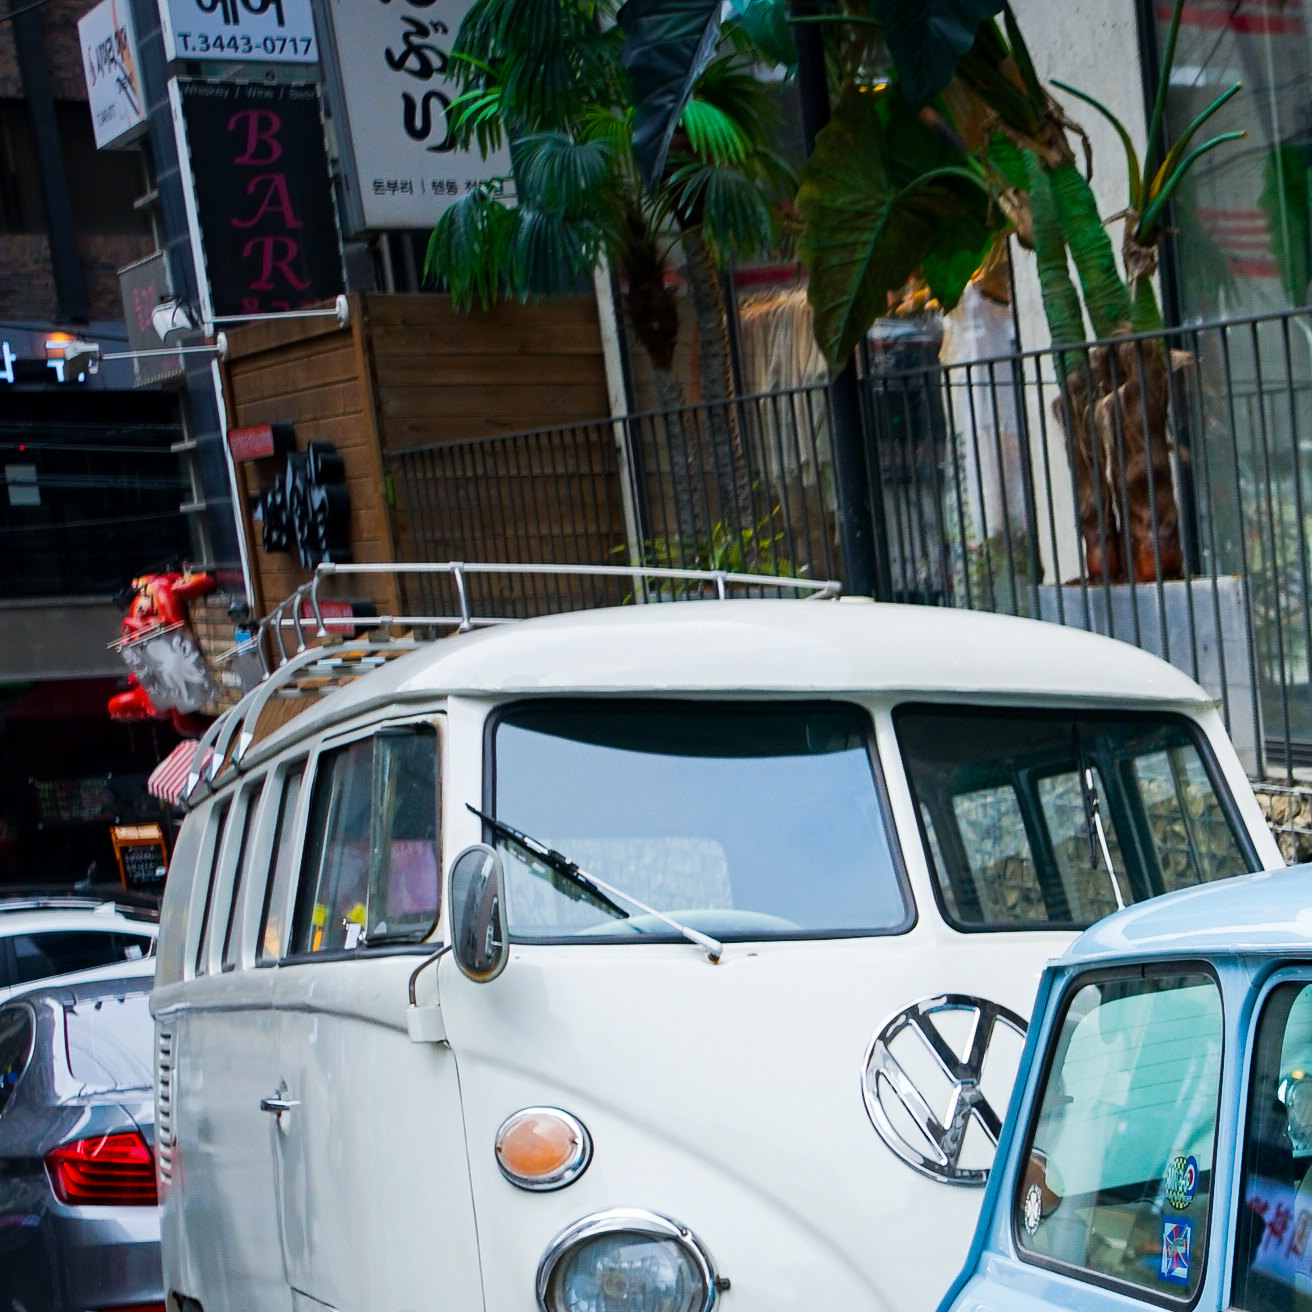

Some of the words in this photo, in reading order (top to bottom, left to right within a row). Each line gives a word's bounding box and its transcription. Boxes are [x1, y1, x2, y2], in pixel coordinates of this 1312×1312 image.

[177, 32, 313, 56] T.3443-0717
[227, 109, 312, 290] BAR
[372, 178, 414, 197] 돈부리
